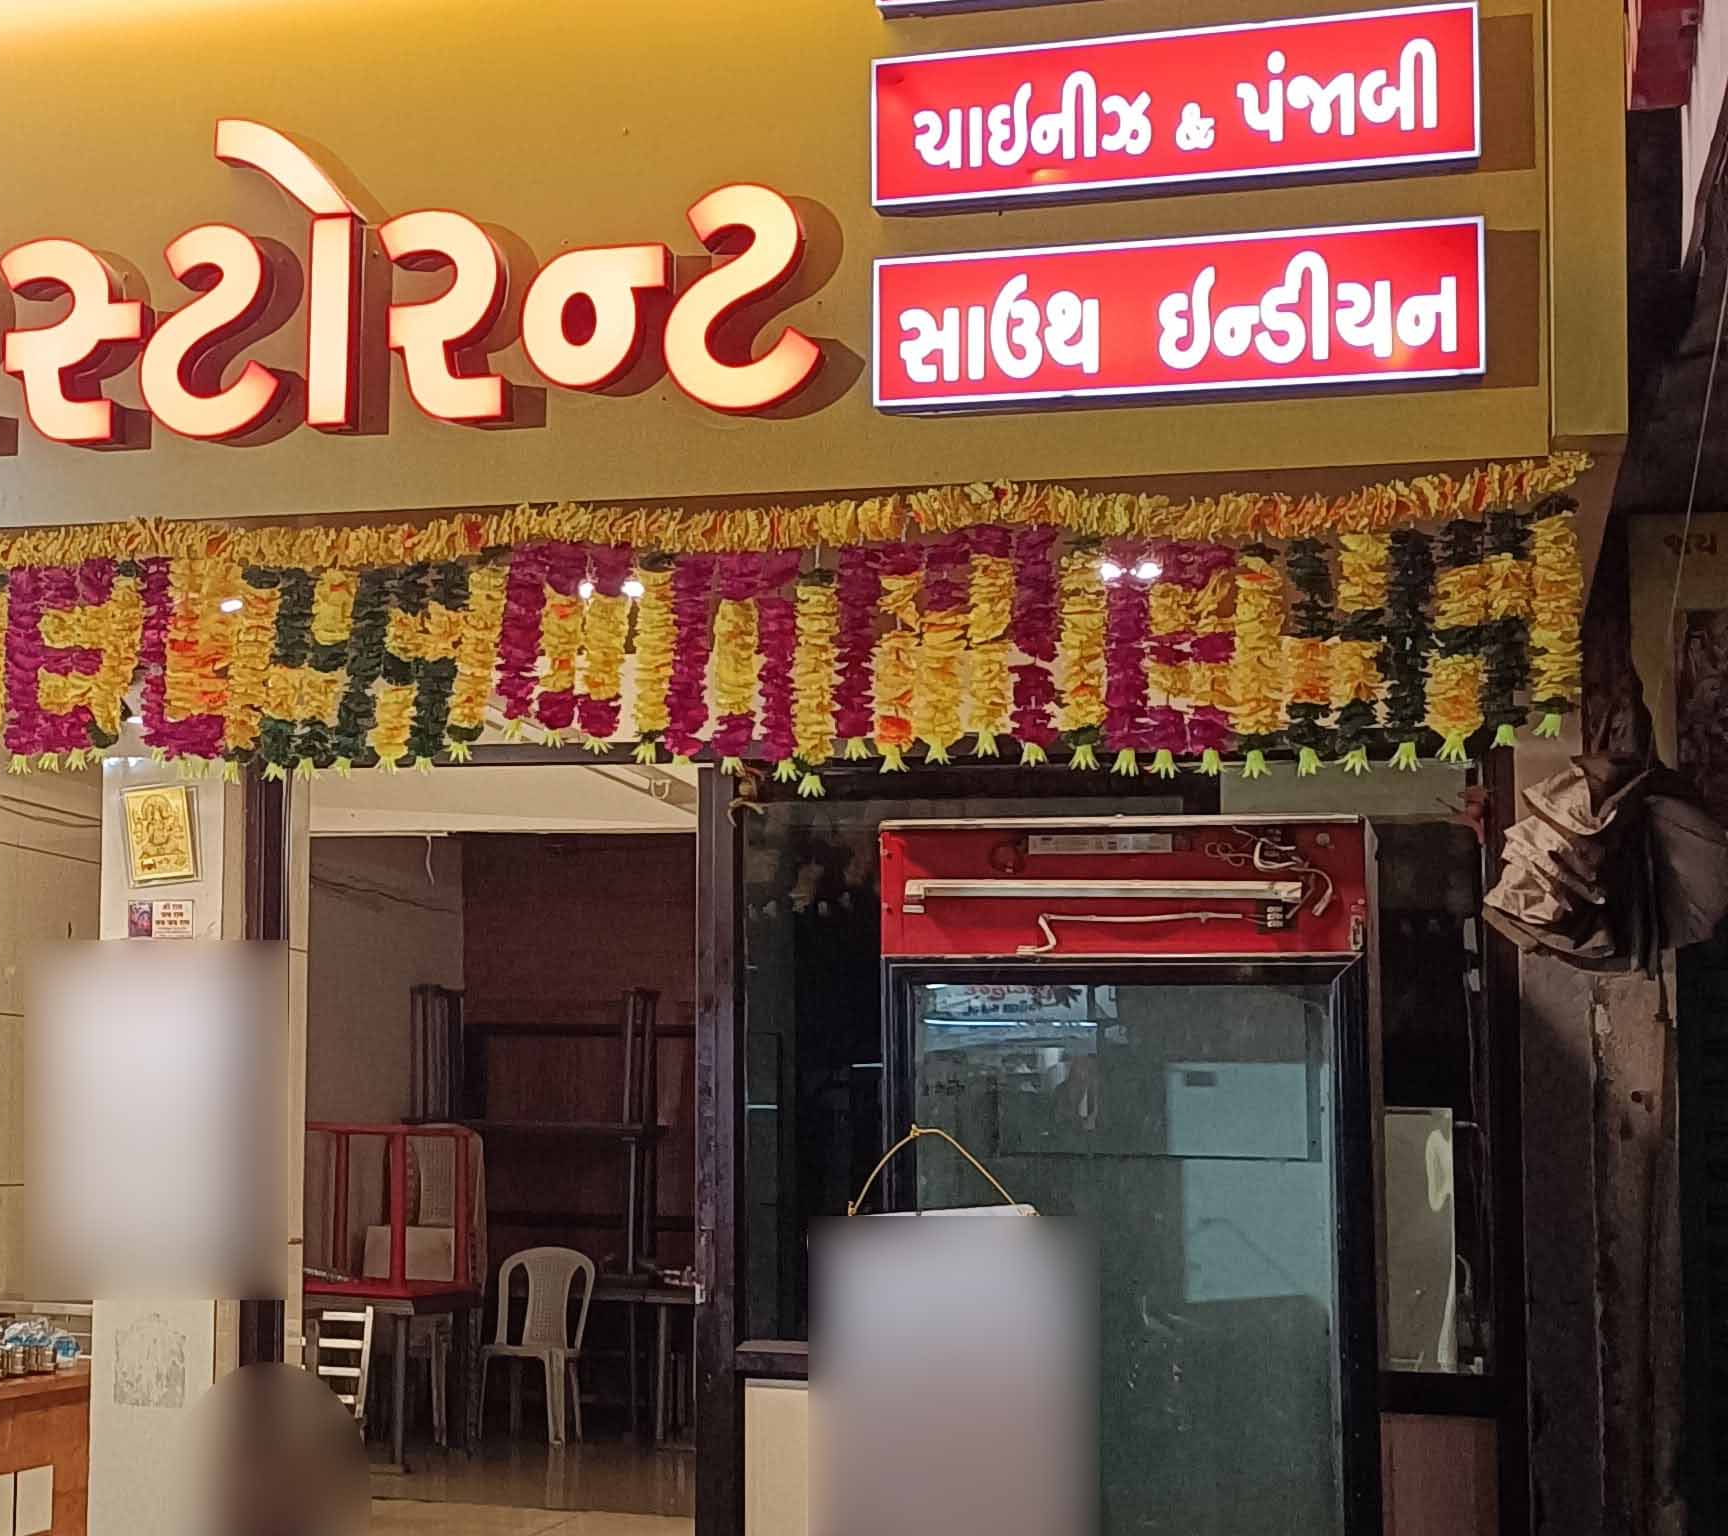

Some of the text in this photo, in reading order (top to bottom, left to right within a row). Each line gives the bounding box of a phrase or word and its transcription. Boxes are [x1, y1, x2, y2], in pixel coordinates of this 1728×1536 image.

[1175, 102, 1215, 152] &
[1236, 37, 1439, 144] પંજાબી
[898, 272, 1101, 384] સાઉથ
